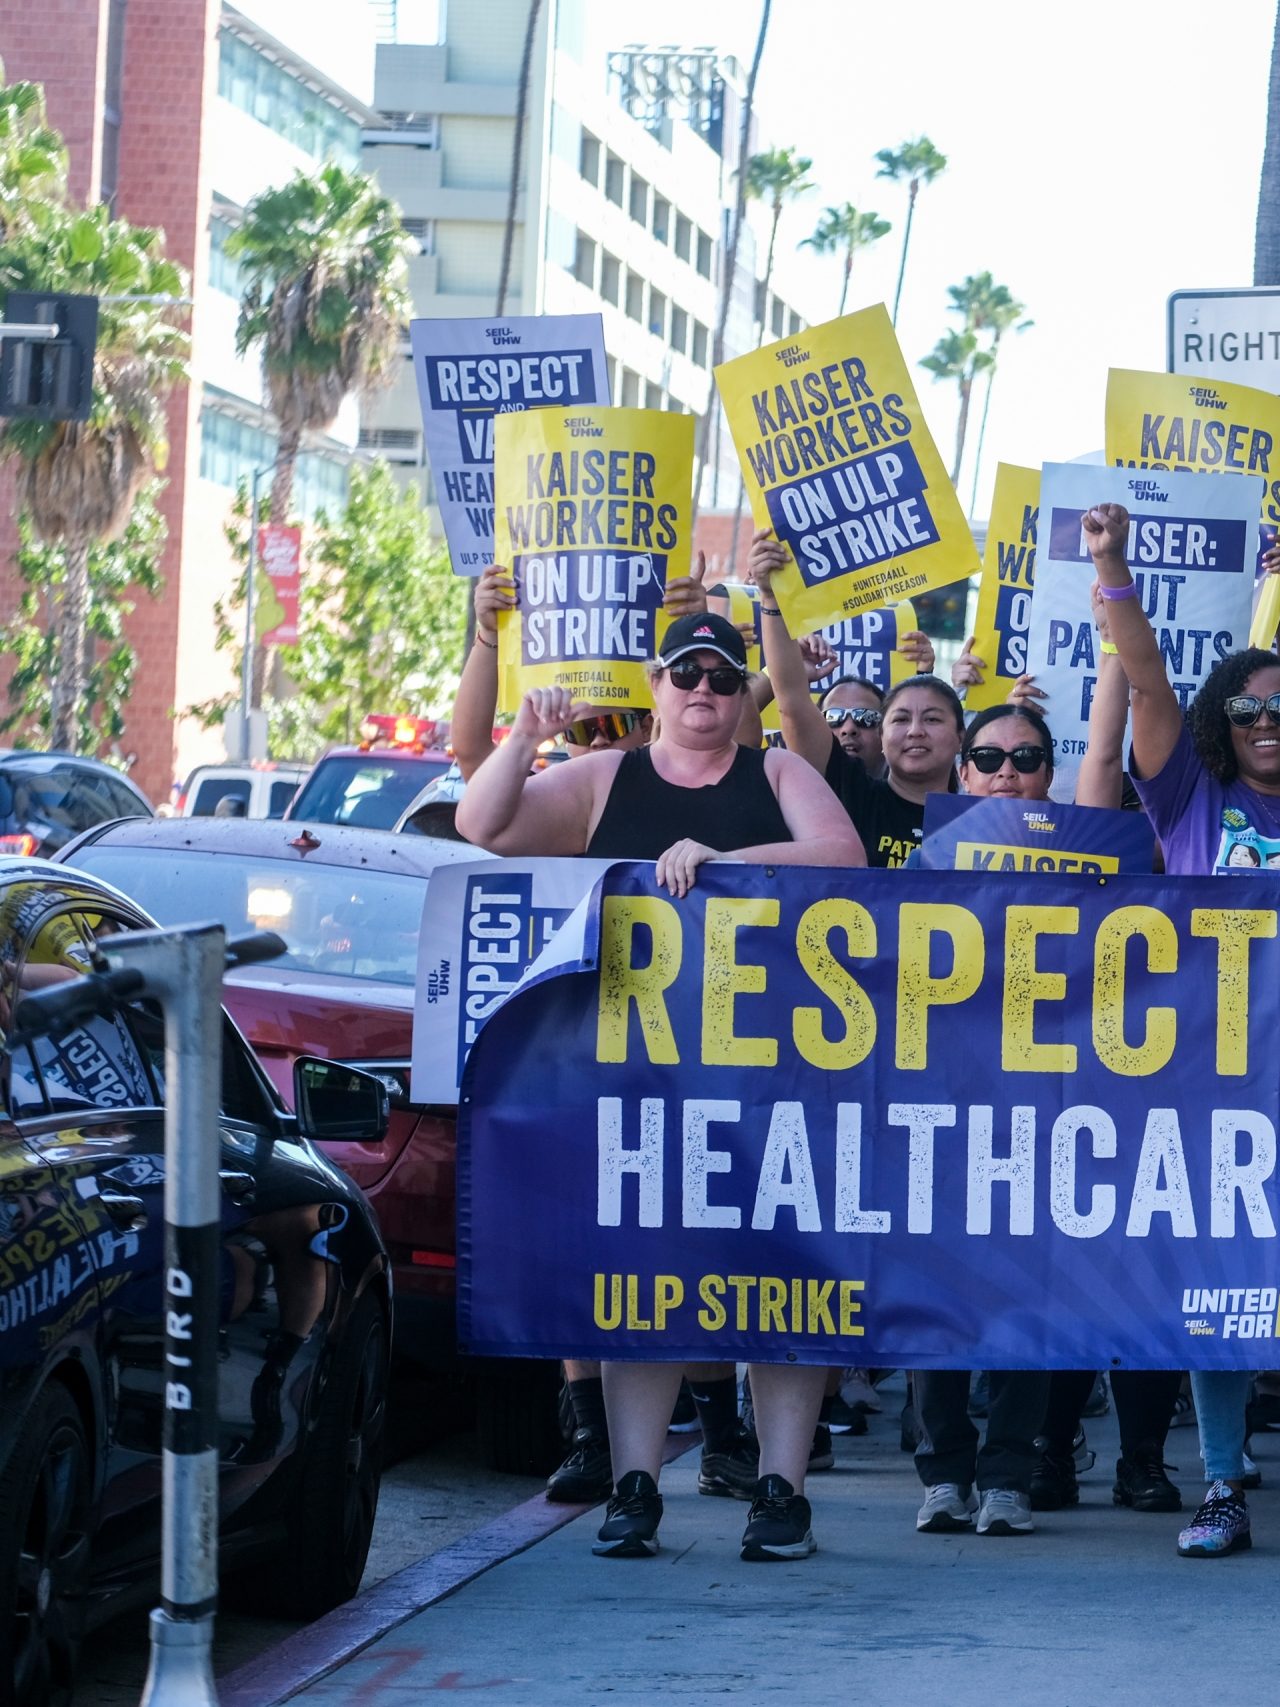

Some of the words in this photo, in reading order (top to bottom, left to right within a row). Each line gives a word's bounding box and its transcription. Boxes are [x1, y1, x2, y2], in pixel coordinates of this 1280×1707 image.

[485, 327, 513, 339] SEIU-
[492, 336, 522, 346] UHW
[775, 345, 803, 362] SEIU-
[783, 352, 811, 369] UHW
[436, 354, 583, 403] RESPECT
[750, 355, 875, 437] KAISER
[1189, 386, 1221, 399] SEIU-
[1194, 398, 1228, 411] UHW
[499, 402, 526, 414] AND
[563, 416, 595, 429] SEIU-
[570, 427, 604, 438] UHW
[745, 392, 913, 489] WORKERS
[1140, 413, 1274, 474] KAISER
[526, 449, 656, 499] KAISER
[1128, 479, 1161, 492] SEIU-
[780, 477, 834, 533] ON
[831, 451, 904, 514] ULP
[1134, 491, 1169, 503] UHW
[506, 499, 679, 550] WORKERS
[799, 497, 932, 579] STRIKE
[1079, 519, 1218, 567] ISER:
[460, 551, 479, 565] ULP
[525, 556, 569, 607] ON
[578, 554, 651, 603] ULP
[842, 573, 928, 612] #SOLIDARITYSEASON
[853, 565, 909, 593] #UNITED4ALL
[527, 607, 649, 660] STRIKE
[554, 671, 613, 684] #UNITED4ALL
[571, 686, 631, 699] ARITYSEASON
[1022, 811, 1049, 822] SEIU-
[1028, 821, 1056, 831] UHW
[427, 969, 438, 1004] SEIU-
[439, 959, 451, 996] UHW
[464, 886, 522, 1064] SPECT
[596, 894, 1279, 1077] RESPECT
[593, 1273, 684, 1332] ULP
[698, 1274, 866, 1336] STRIKE
[1181, 1287, 1278, 1314] UNITED
[165, 1266, 193, 1411] BIRD
[1189, 1327, 1216, 1336] UHW
[1222, 1313, 1274, 1339] FOR
